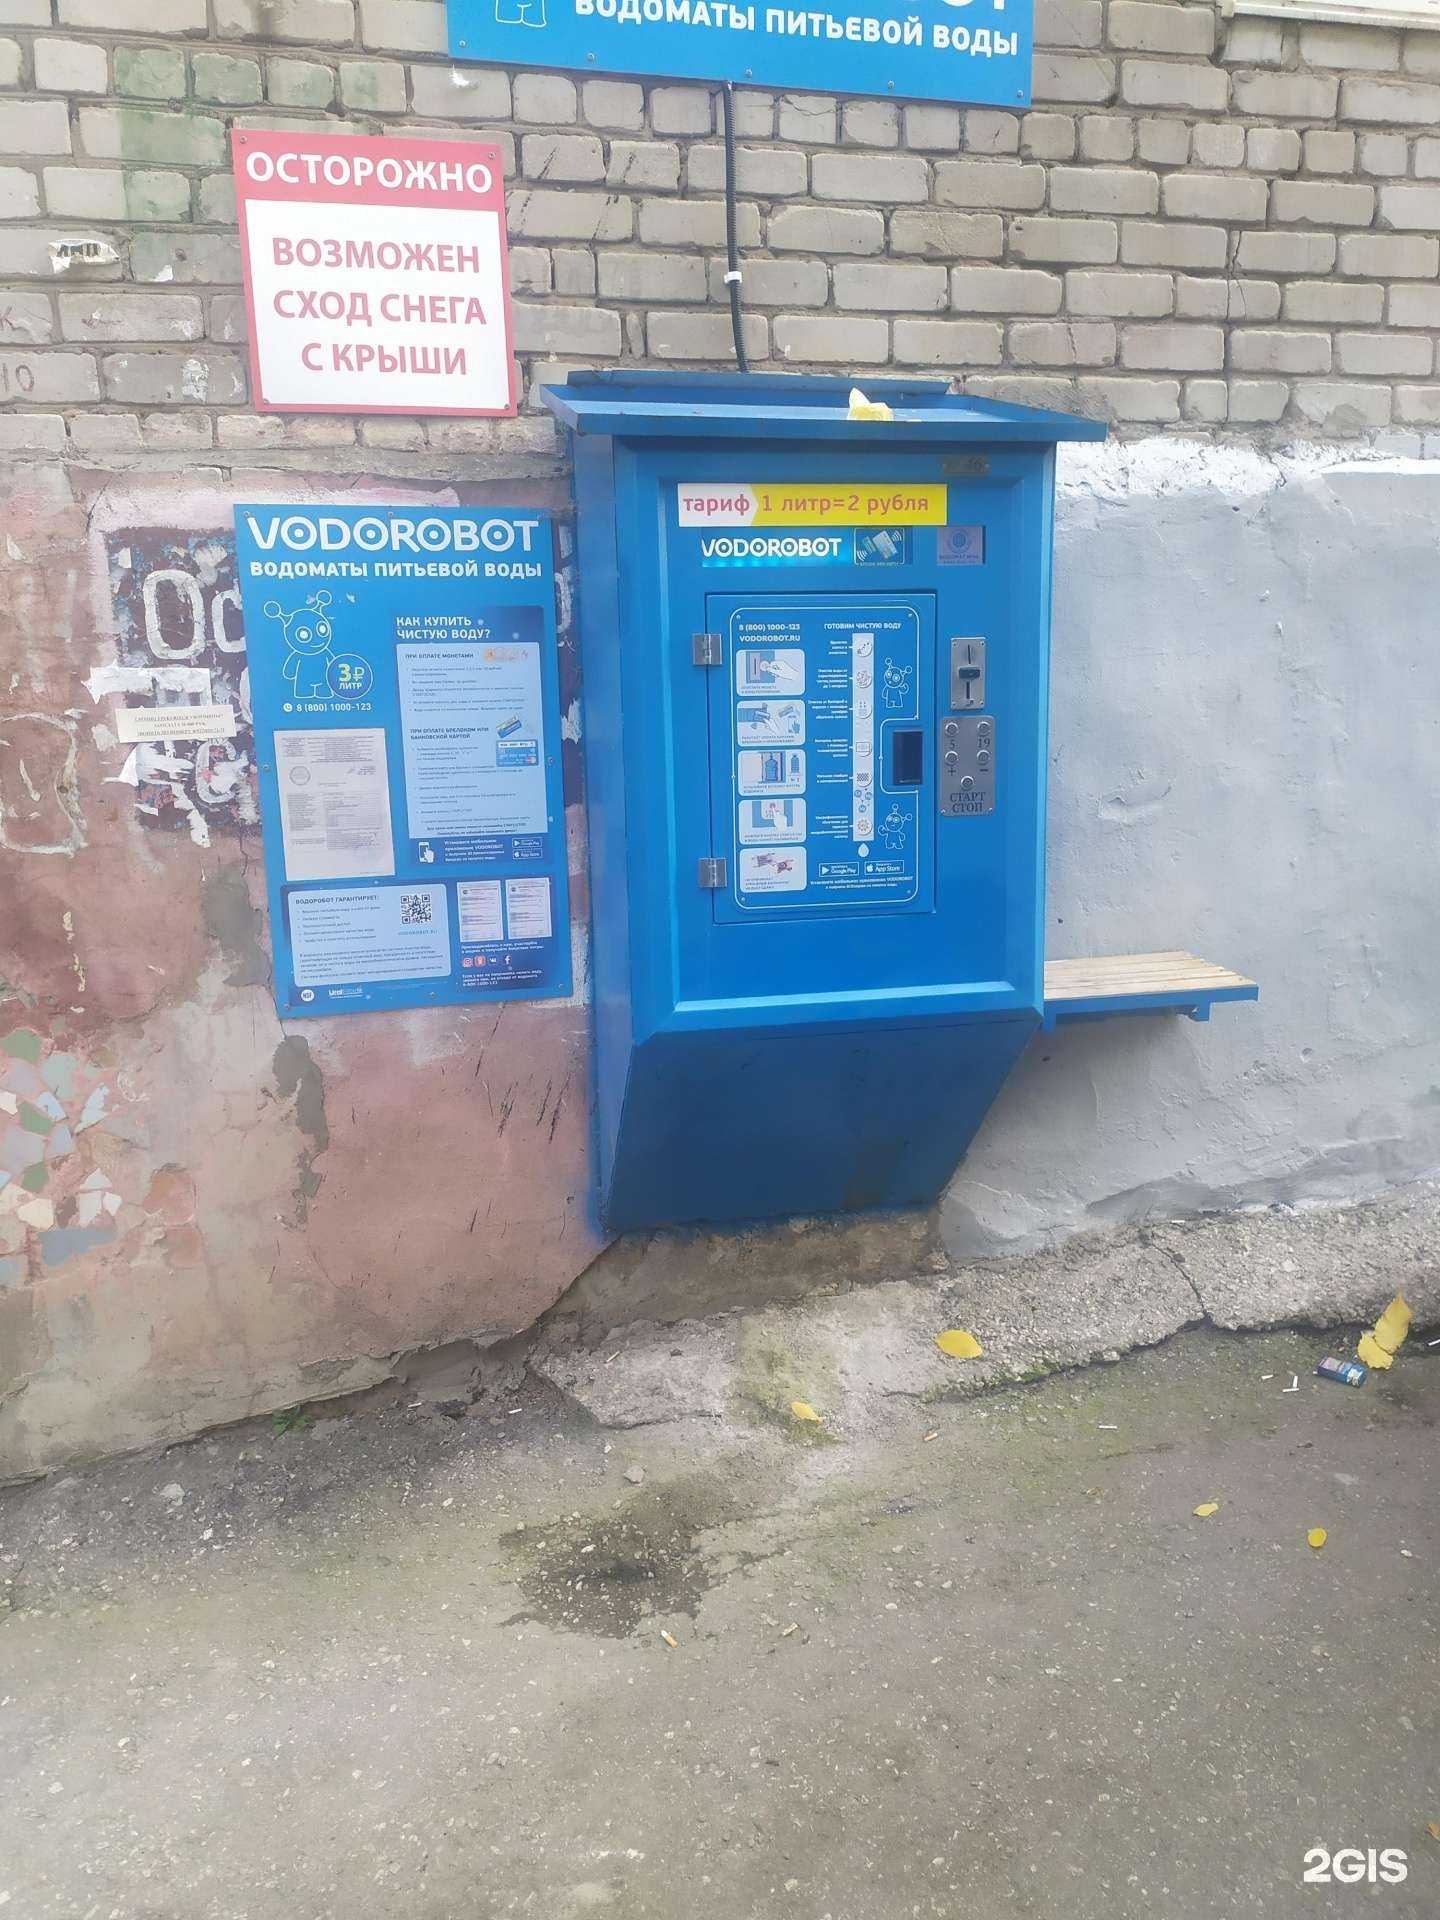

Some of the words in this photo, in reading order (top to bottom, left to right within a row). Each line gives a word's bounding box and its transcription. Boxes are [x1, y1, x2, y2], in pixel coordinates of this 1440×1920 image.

[575, 0, 755, 31] ВОДОМАТЫ
[766, 8, 923, 47] ПИТЬЕВОЙ
[933, 24, 1018, 58] ВОДЫ
[246, 151, 493, 194] ОСТОРОЖНО
[272, 237, 480, 274] ВОЗМОЖЕН
[273, 289, 373, 327] СХОД
[380, 294, 487, 326] СНЕГА
[301, 342, 325, 371] С
[332, 343, 467, 375] КРЫШИ
[683, 494, 750, 516] тариф
[762, 495, 773, 511] 1
[867, 494, 929, 515] рубля
[248, 515, 540, 553] VODOROBOT
[701, 537, 843, 559] VODOROBOT
[250, 561, 367, 580] ВОДОМАТЫ
[374, 559, 478, 578] ПИТЬЕВОЙ
[484, 562, 542, 579] ВОДЫ
[396, 616, 421, 626] КАК
[424, 616, 472, 626] КУПИТЬ
[397, 629, 448, 640] ЧИСТУЮ
[451, 629, 491, 640] ВОДУ?
[739, 634, 801, 642] VODOROBOT.RU
[339, 682, 363, 691] ЛИТР
[330, 702, 372, 712] 1000-123
[950, 791, 986, 803] СТАРТ
[952, 802, 984, 814] СТОП
